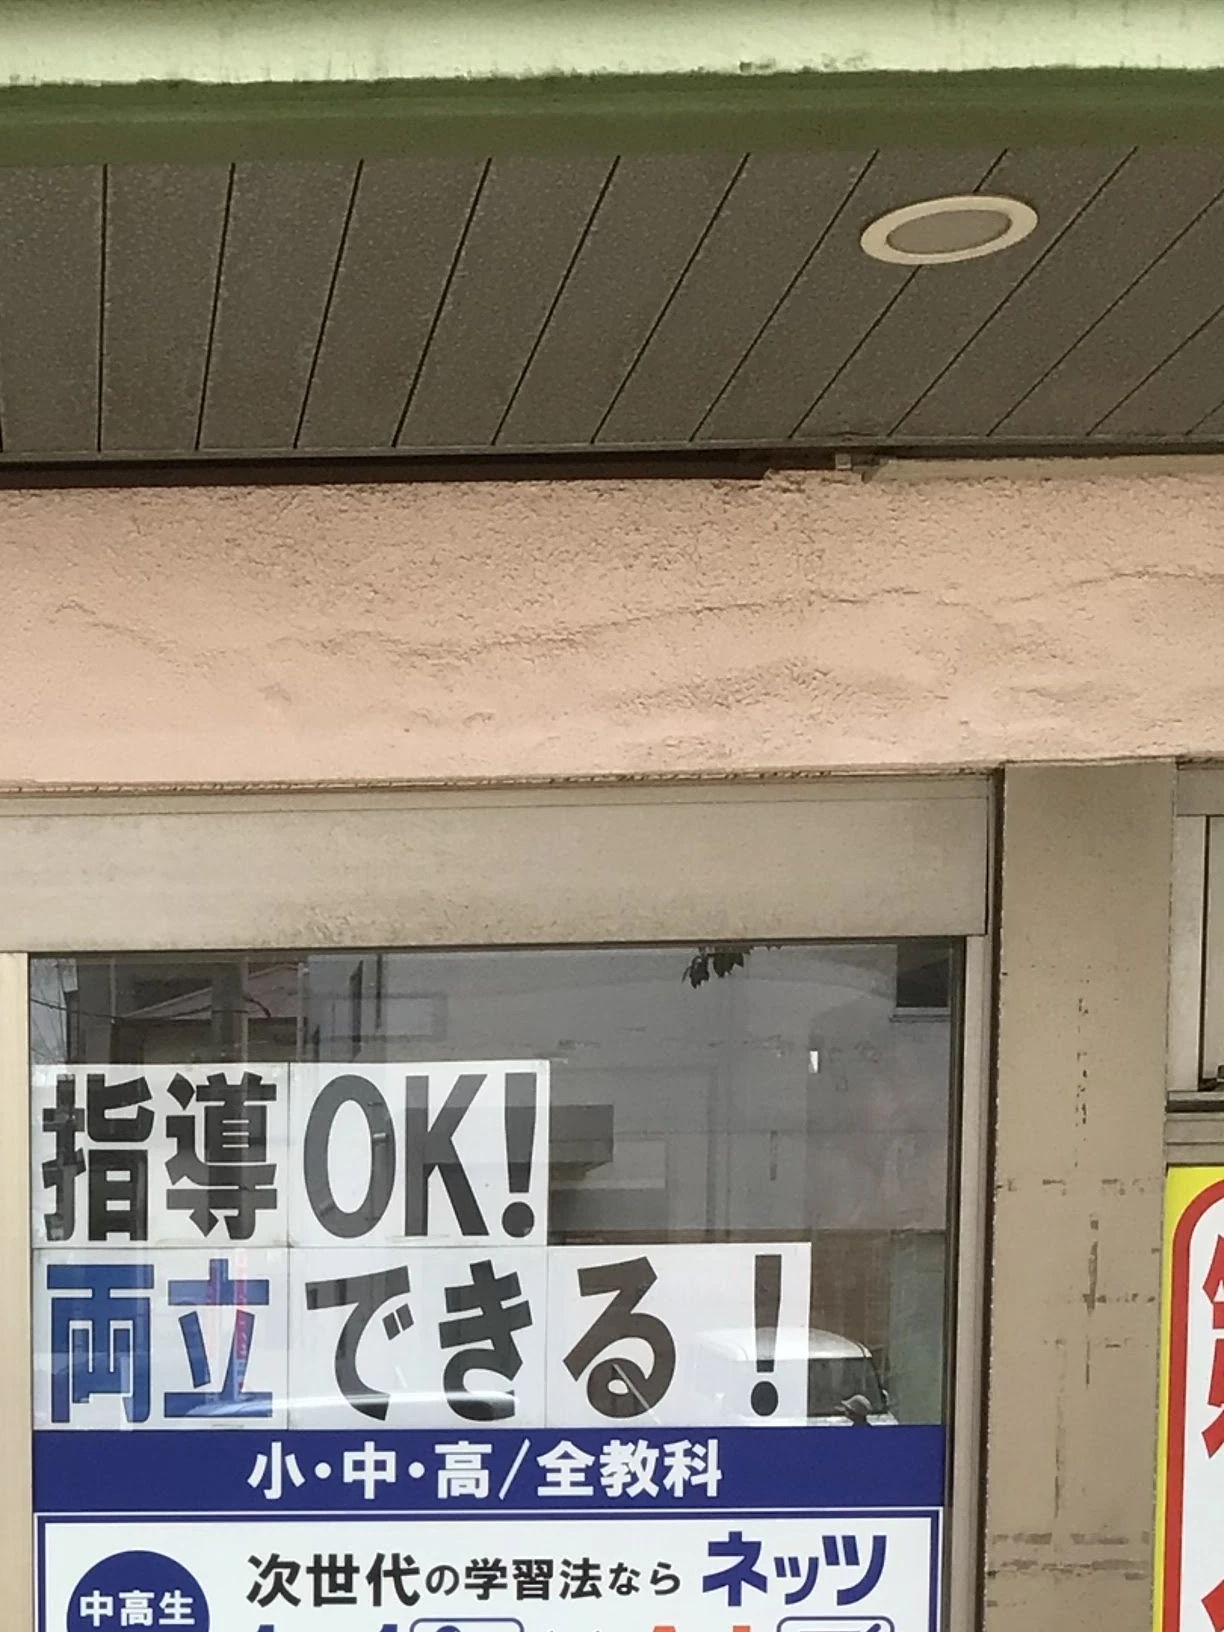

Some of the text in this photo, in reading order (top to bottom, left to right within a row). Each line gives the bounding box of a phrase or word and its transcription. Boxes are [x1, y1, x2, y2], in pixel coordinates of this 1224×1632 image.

[246, 1530, 887, 1608] 次世代の学習法なら ネッツ
[79, 1590, 195, 1627] 中高生
